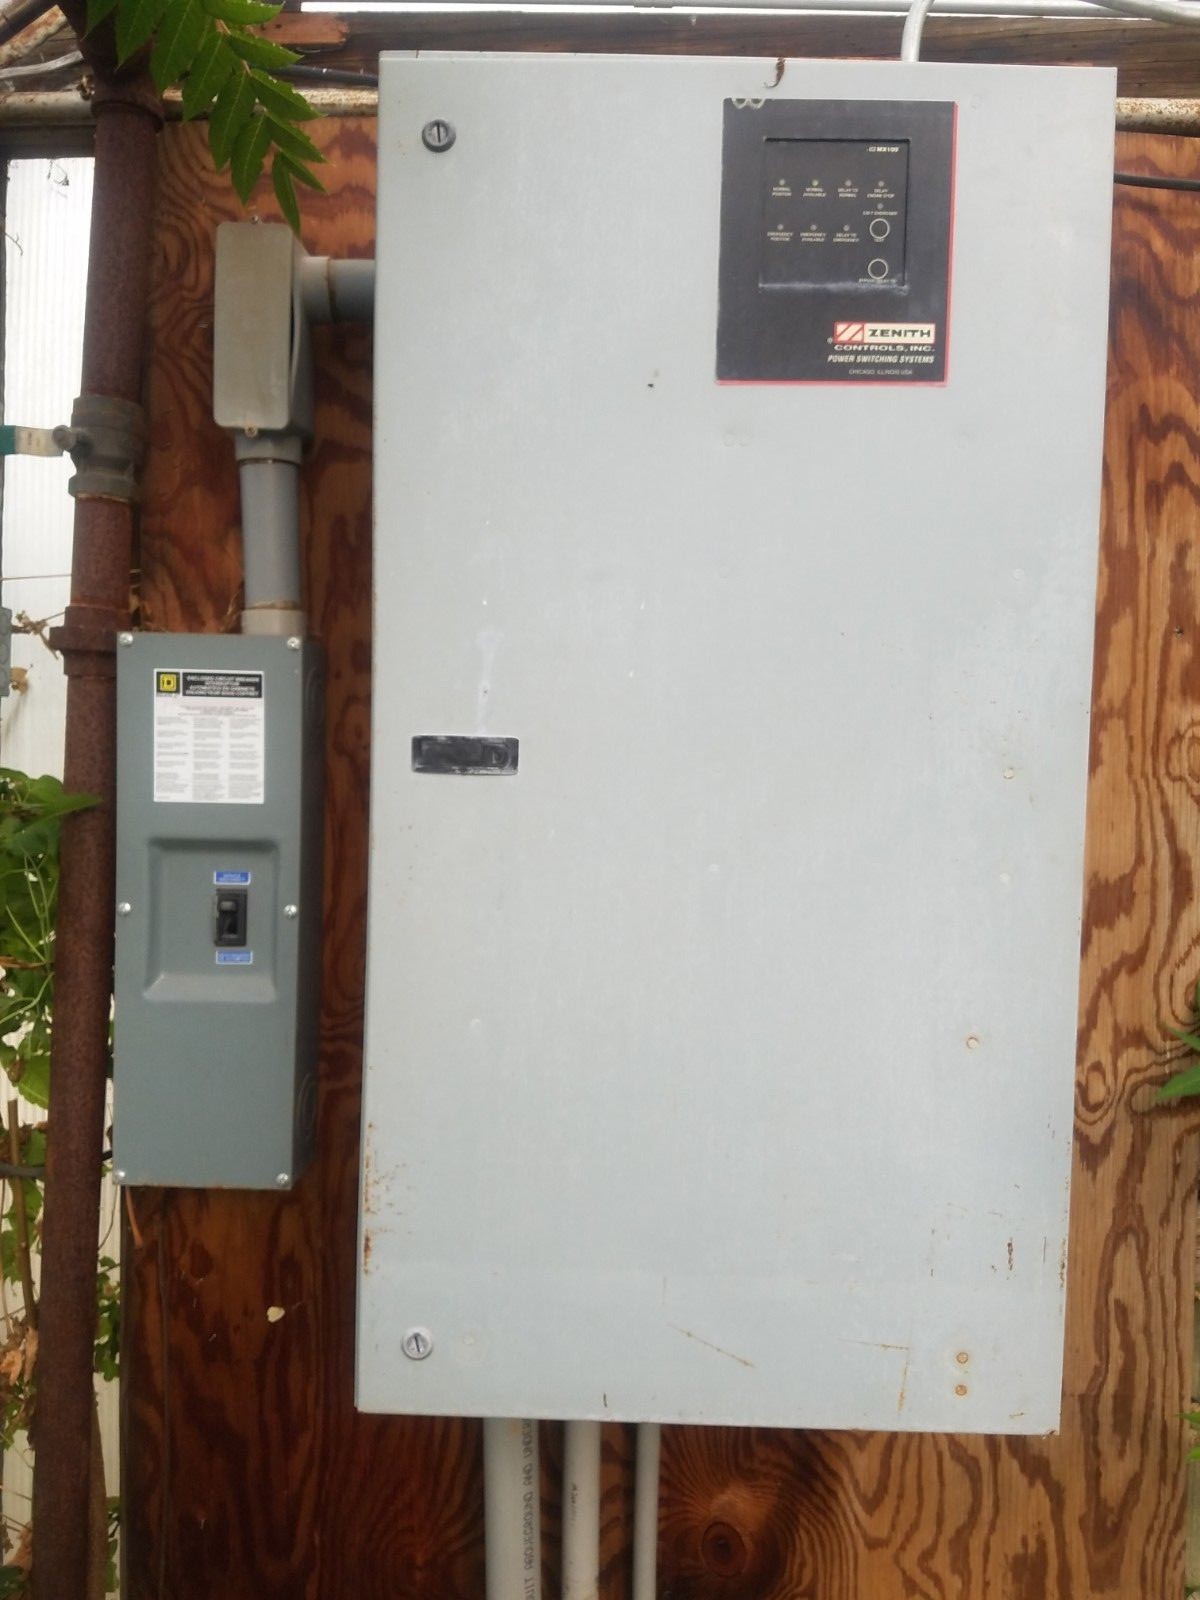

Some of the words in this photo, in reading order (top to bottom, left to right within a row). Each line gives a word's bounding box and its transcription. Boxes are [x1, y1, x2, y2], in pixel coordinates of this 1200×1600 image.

[868, 328, 931, 338] ZENITH
[833, 344, 908, 352] CONTROLS,
[827, 354, 855, 363] POWER
[855, 355, 898, 364] SWITCHING
[899, 355, 935, 364] SYSTEMS
